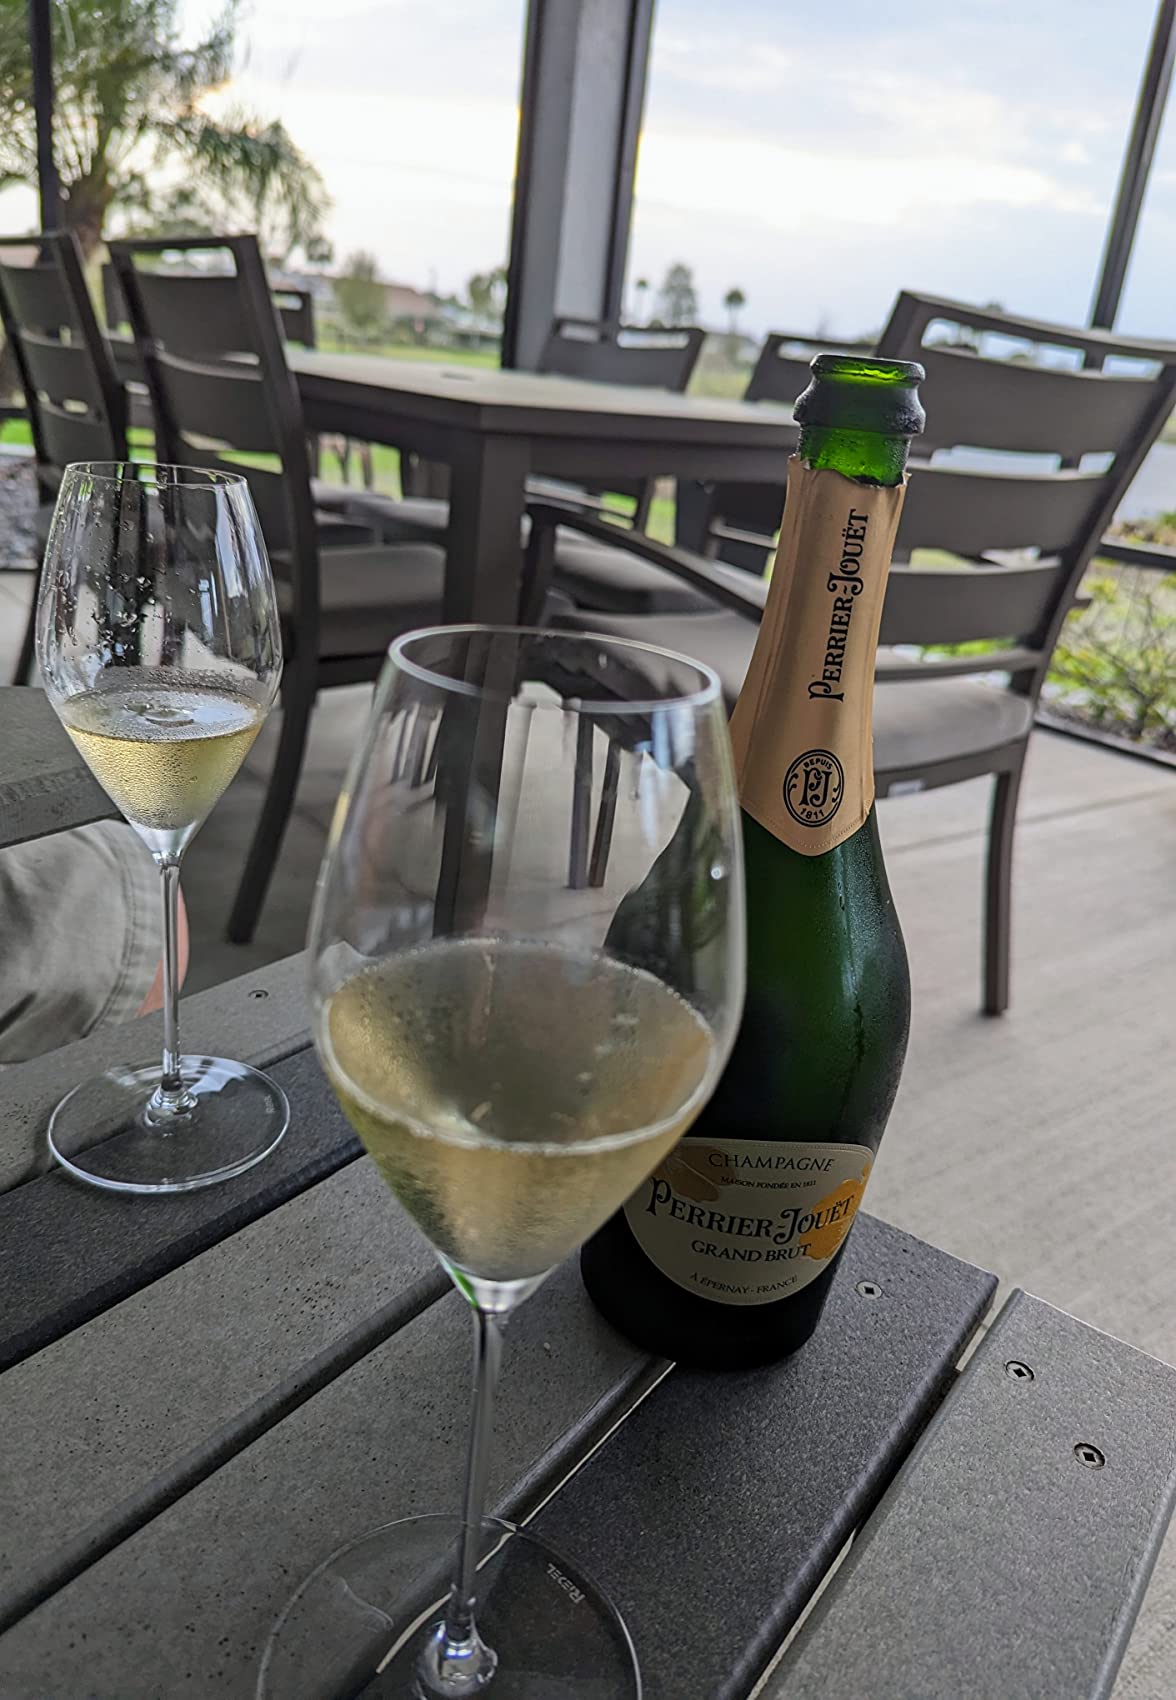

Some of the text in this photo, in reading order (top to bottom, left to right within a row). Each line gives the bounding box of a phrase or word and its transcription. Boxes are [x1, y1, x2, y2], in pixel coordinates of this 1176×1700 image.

[803, 758, 833, 770] DEPUIS
[800, 807, 825, 820] 1811
[708, 1153, 835, 1172] CHAMPAGNE
[691, 1239, 812, 1262] GRAND BRUT
[756, 1274, 798, 1294] FRANCE
